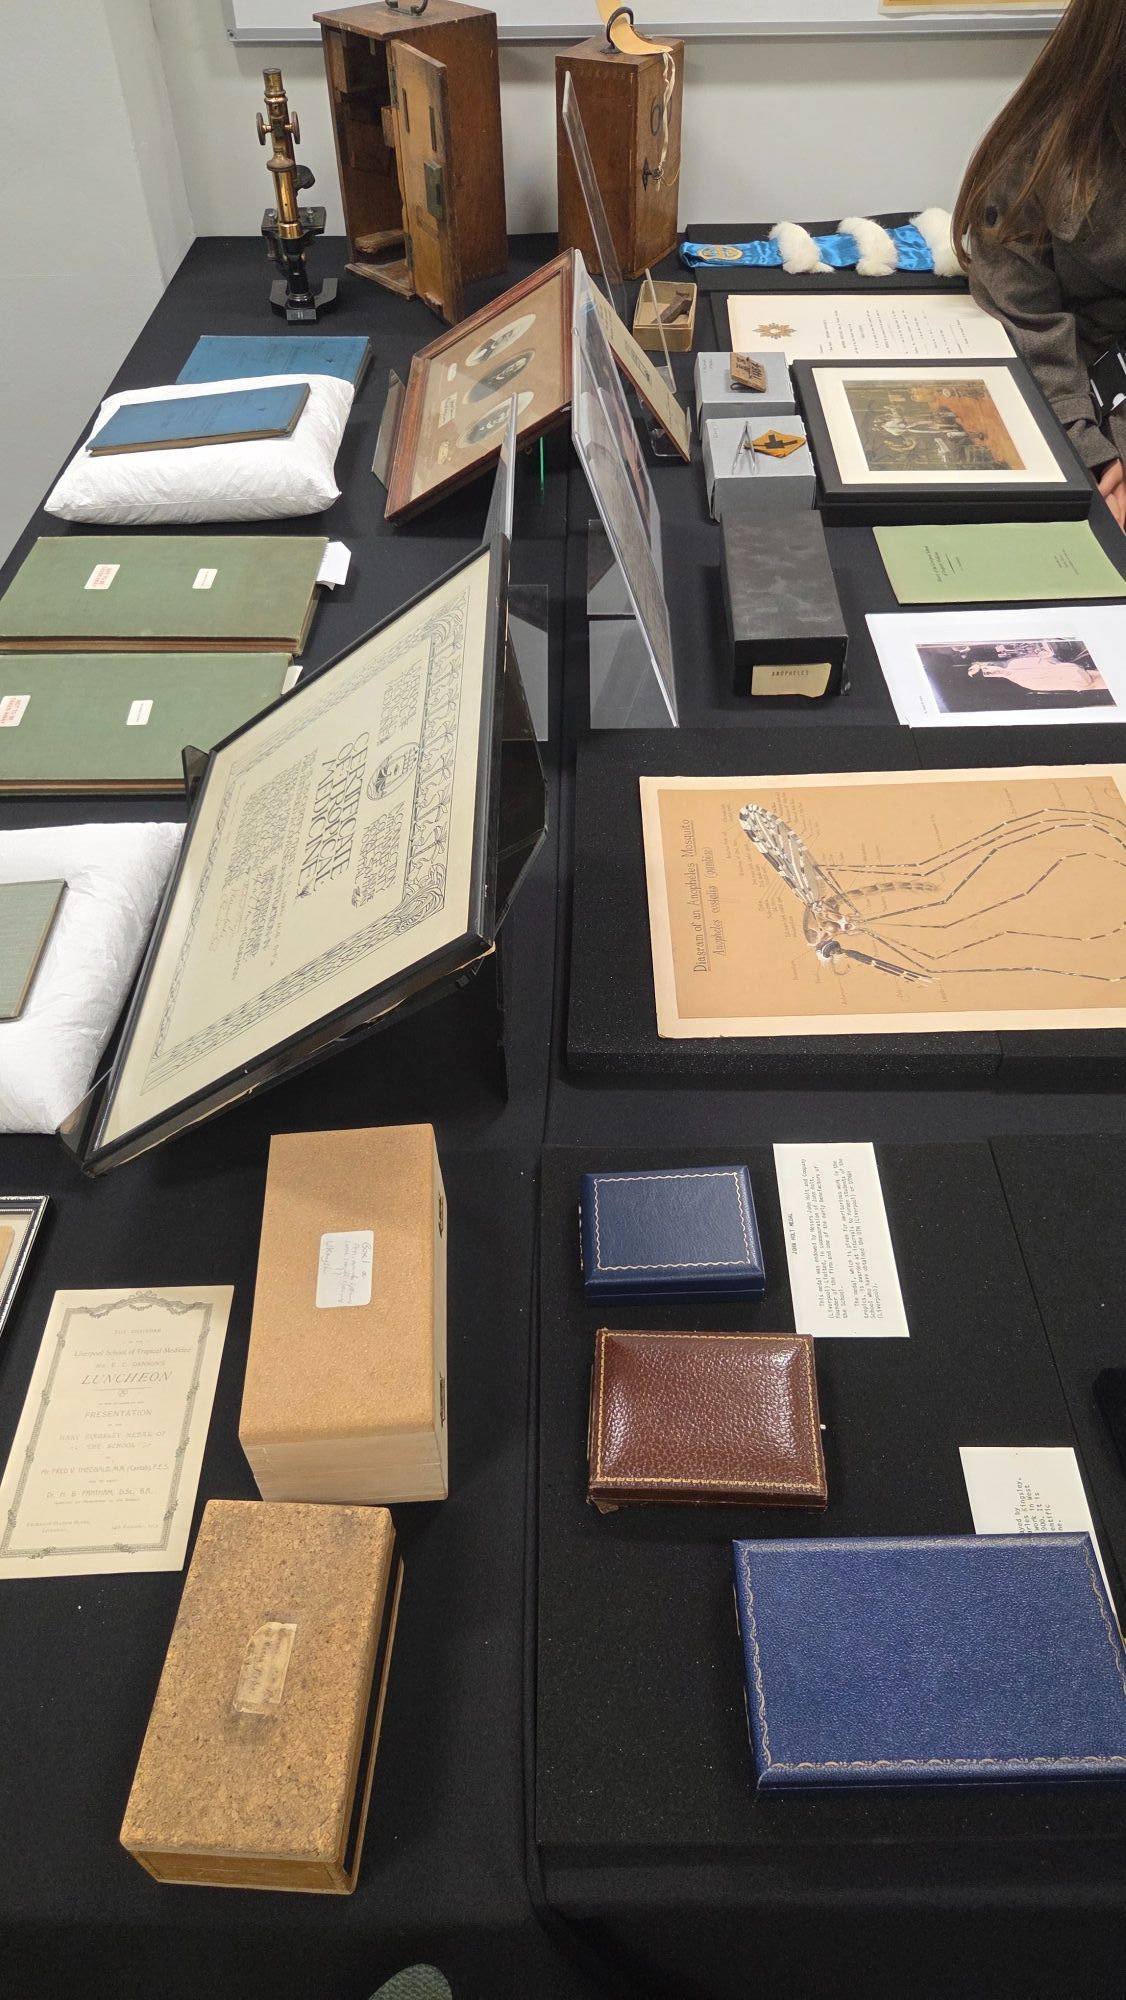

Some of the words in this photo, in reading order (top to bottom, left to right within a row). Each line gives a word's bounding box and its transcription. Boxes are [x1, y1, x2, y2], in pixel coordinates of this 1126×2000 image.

[329, 728, 370, 883] CERTIFICATE
[297, 756, 337, 888] MEDICINE
[681, 819, 696, 857] Mosquito
[684, 863, 702, 905] Anopheles
[692, 910, 700, 920] an
[691, 922, 703, 931] of
[710, 920, 727, 955] Anopheles
[693, 935, 708, 972] Diagram
[137, 1347, 161, 1356] Tropical
[80, 1371, 173, 1385] LUNCHEON
[84, 1409, 152, 1419] PRESENTATION
[1024, 1485, 1033, 1500] West
[1031, 1516, 1040, 1530] work
